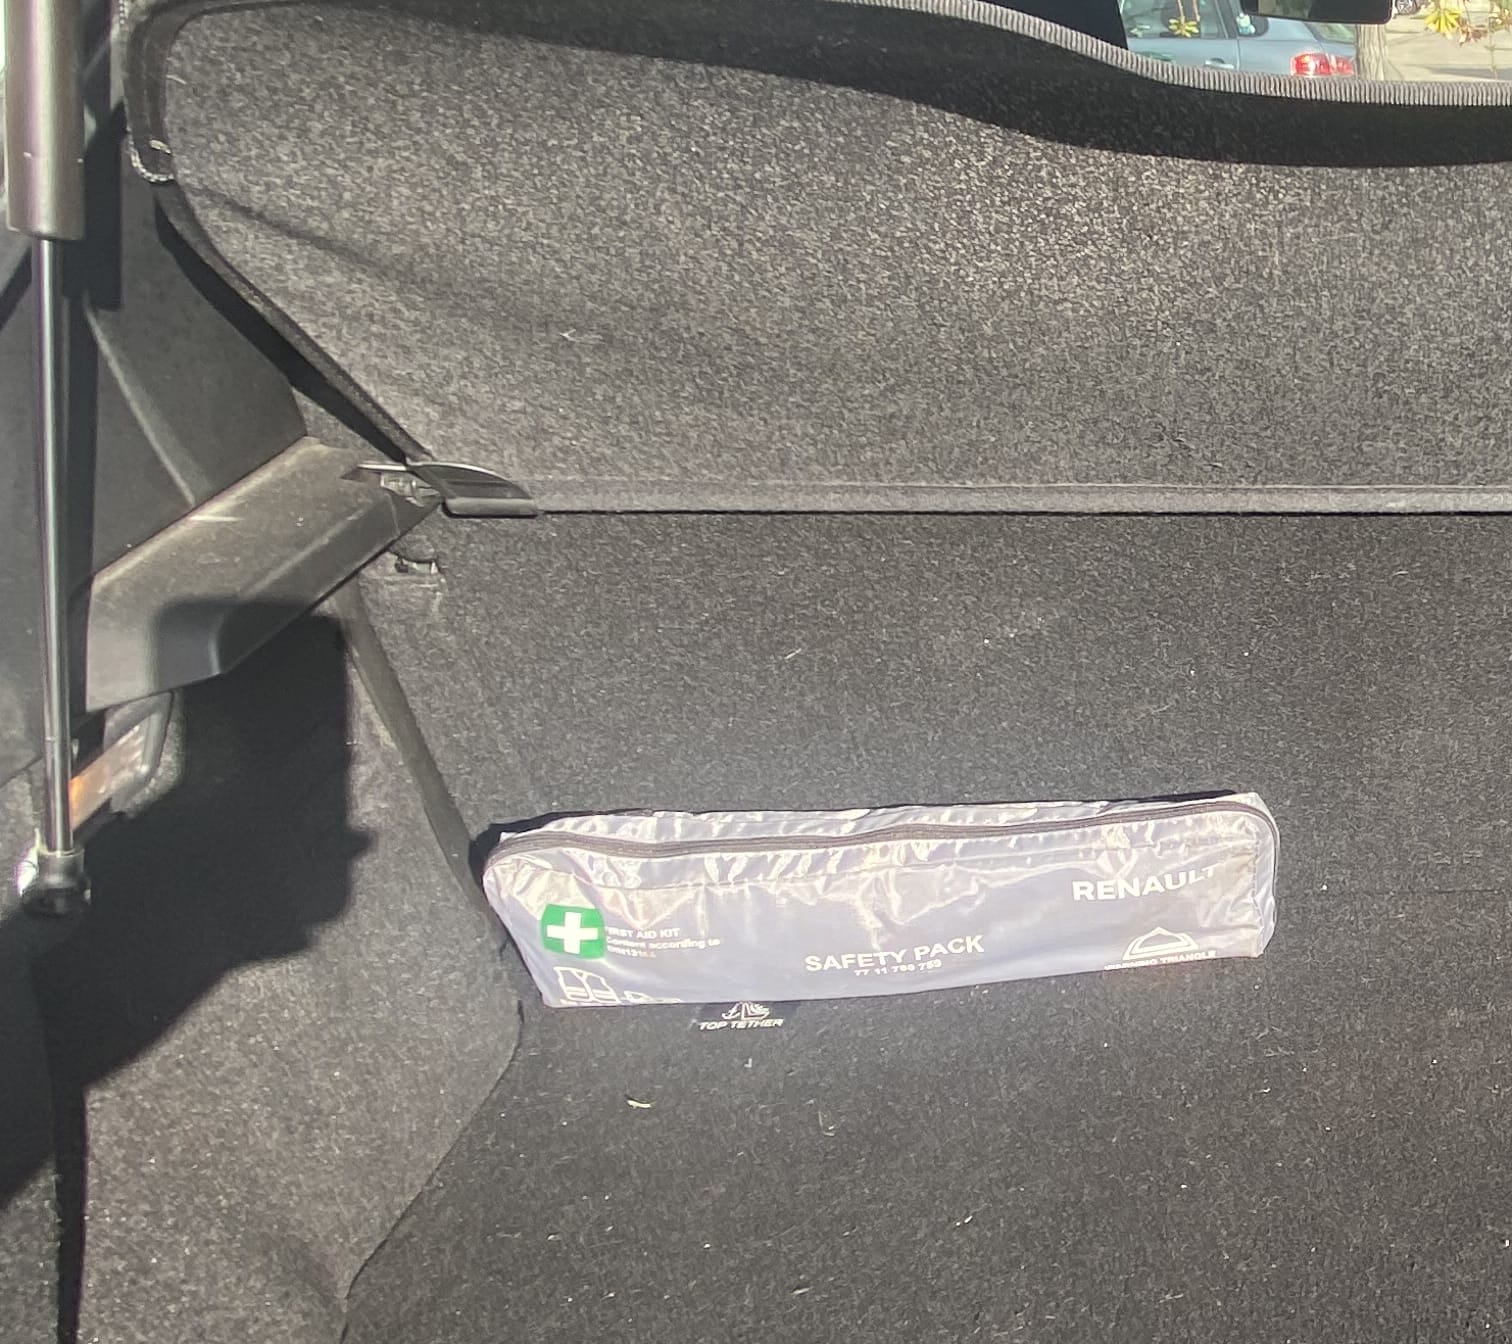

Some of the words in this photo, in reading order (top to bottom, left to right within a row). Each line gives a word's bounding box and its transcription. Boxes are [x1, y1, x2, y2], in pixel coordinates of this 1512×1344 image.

[1072, 864, 1220, 901] RENAULT
[636, 928, 657, 938] AID
[660, 927, 681, 938] KIT
[648, 938, 706, 949] according
[708, 938, 721, 947] to
[804, 948, 908, 972] SAFETY
[913, 934, 985, 961] PACK
[1159, 949, 1217, 965] TRIANGLE
[699, 1020, 728, 1031] TOP
[730, 1018, 784, 1029] TETHER
